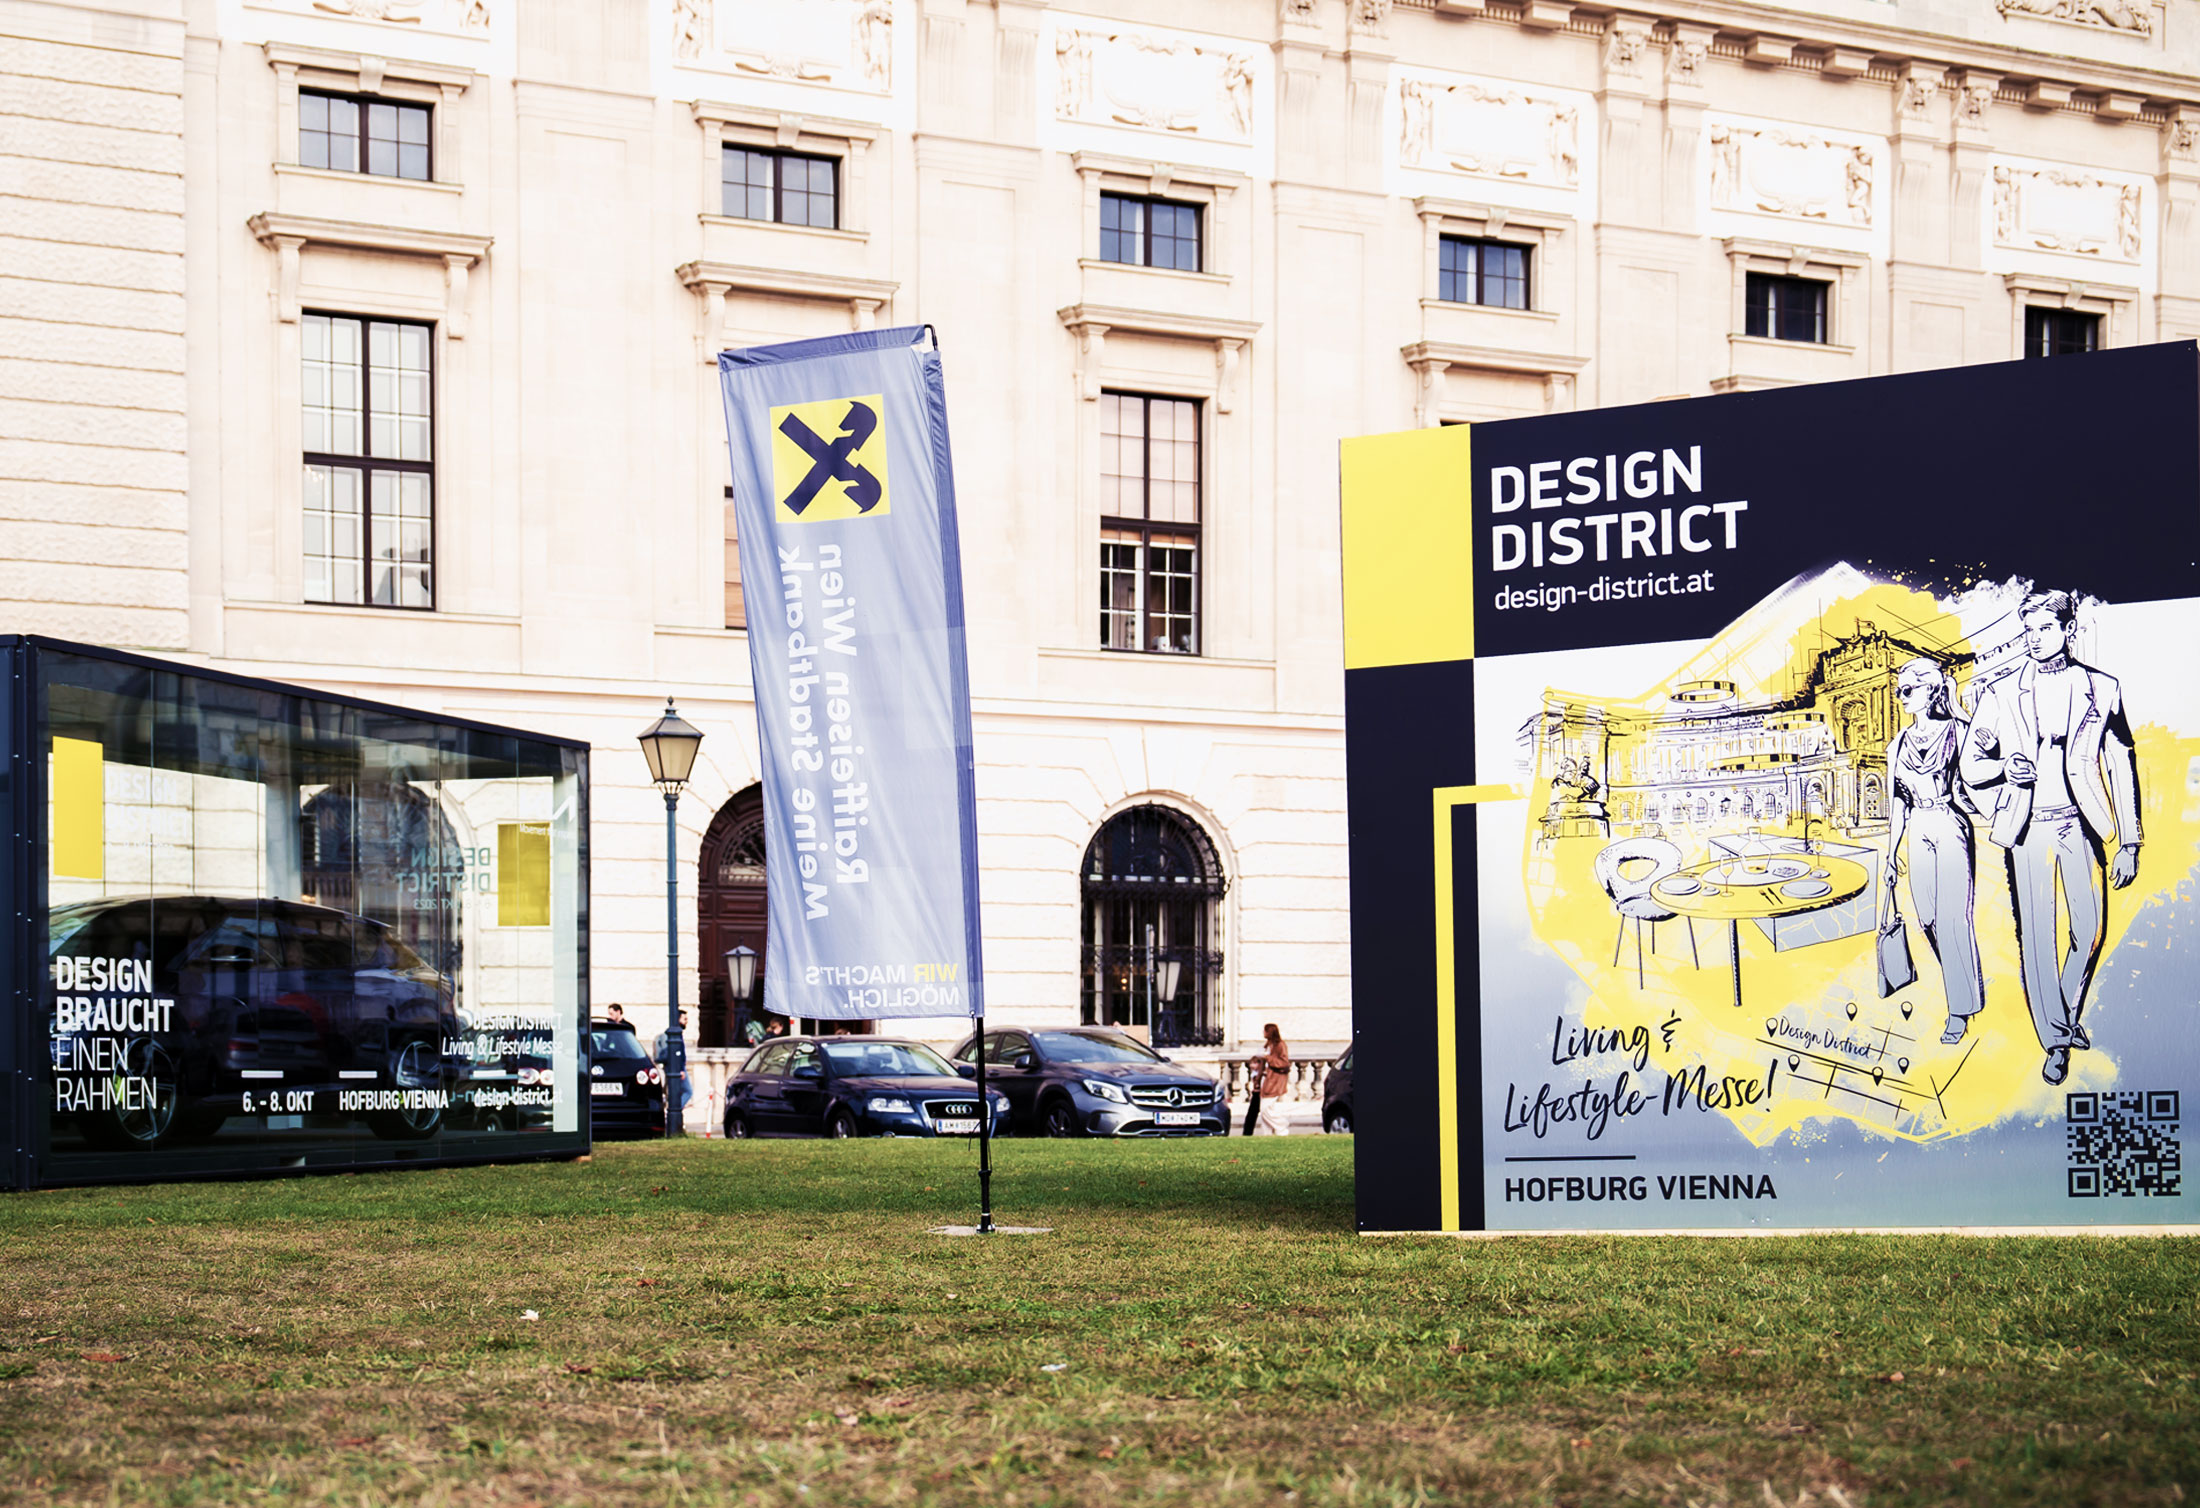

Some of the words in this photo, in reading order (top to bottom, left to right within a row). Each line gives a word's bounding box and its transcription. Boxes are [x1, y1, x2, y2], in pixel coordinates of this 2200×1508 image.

[1490, 444, 1702, 513] DESIGN
[1491, 499, 1749, 572] DISTRICT
[1494, 568, 1715, 612] design-district.at
[56, 955, 152, 993] DESIGN
[56, 996, 175, 1032] BRAUCHT
[473, 1014, 515, 1031] DESIGN
[517, 1012, 563, 1030] DISTRICT
[56, 1037, 129, 1071] EINEN
[442, 1036, 475, 1060] Living
[476, 1033, 488, 1055] &
[489, 1035, 532, 1060] Lifestyle
[532, 1036, 563, 1056] Messe
[1552, 1015, 1651, 1070] Living
[1779, 1015, 1822, 1049] Design
[1823, 1027, 1870, 1060] District
[56, 1076, 157, 1112] RAHMEN
[242, 1091, 256, 1112] 6.
[270, 1090, 283, 1112] 8.
[286, 1090, 315, 1112] OKT
[339, 1089, 400, 1111] HOFBURG
[402, 1088, 450, 1110] VIENNA
[473, 1086, 563, 1111] design-district.at
[1503, 1057, 1779, 1141] Lifestyle-Messe!
[1505, 1175, 1648, 1203] HOFBURG
[1655, 1173, 1778, 1201] VIENNA
